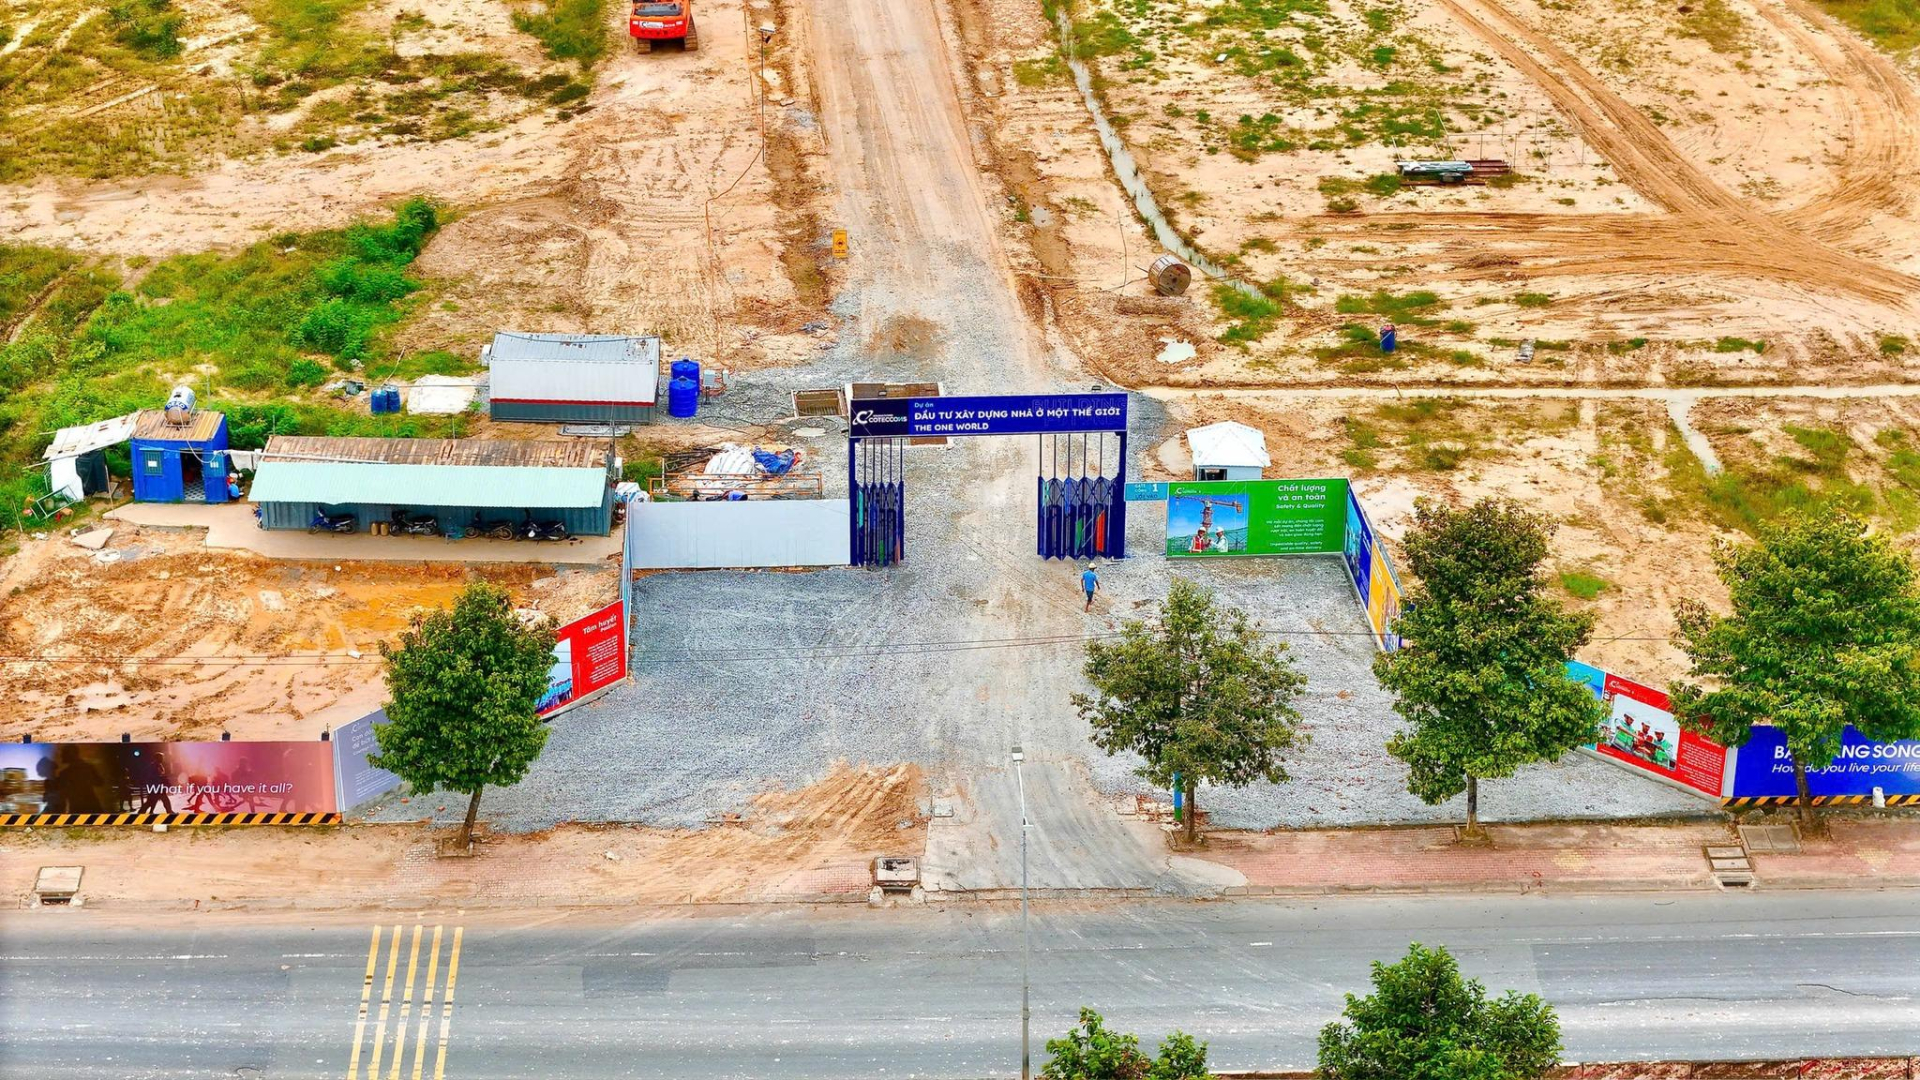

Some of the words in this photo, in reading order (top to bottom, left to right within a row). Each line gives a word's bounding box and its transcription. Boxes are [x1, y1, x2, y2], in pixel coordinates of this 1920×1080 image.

[938, 411, 953, 420] TƯ
[955, 409, 975, 420] XÂY
[978, 409, 1008, 420] DỰNG
[1036, 407, 1044, 417] Ở
[1047, 408, 1069, 418] MỘT
[1072, 405, 1092, 417] THẾ
[1095, 407, 1121, 416] GIỚI
[914, 424, 932, 432] THE
[934, 423, 954, 431] ONE
[955, 422, 989, 431] WORLD
[1152, 483, 1158, 492] 1
[1277, 483, 1298, 492] Chất
[1301, 484, 1326, 493] lượng
[1820, 764, 1846, 775] you
[1848, 762, 1870, 773] live
[1869, 764, 1901, 775] your
[146, 783, 182, 794] What
[186, 782, 195, 793] if
[197, 784, 220, 796] you
[223, 782, 255, 793] have
[258, 783, 267, 793] it
[269, 782, 293, 793] all?
